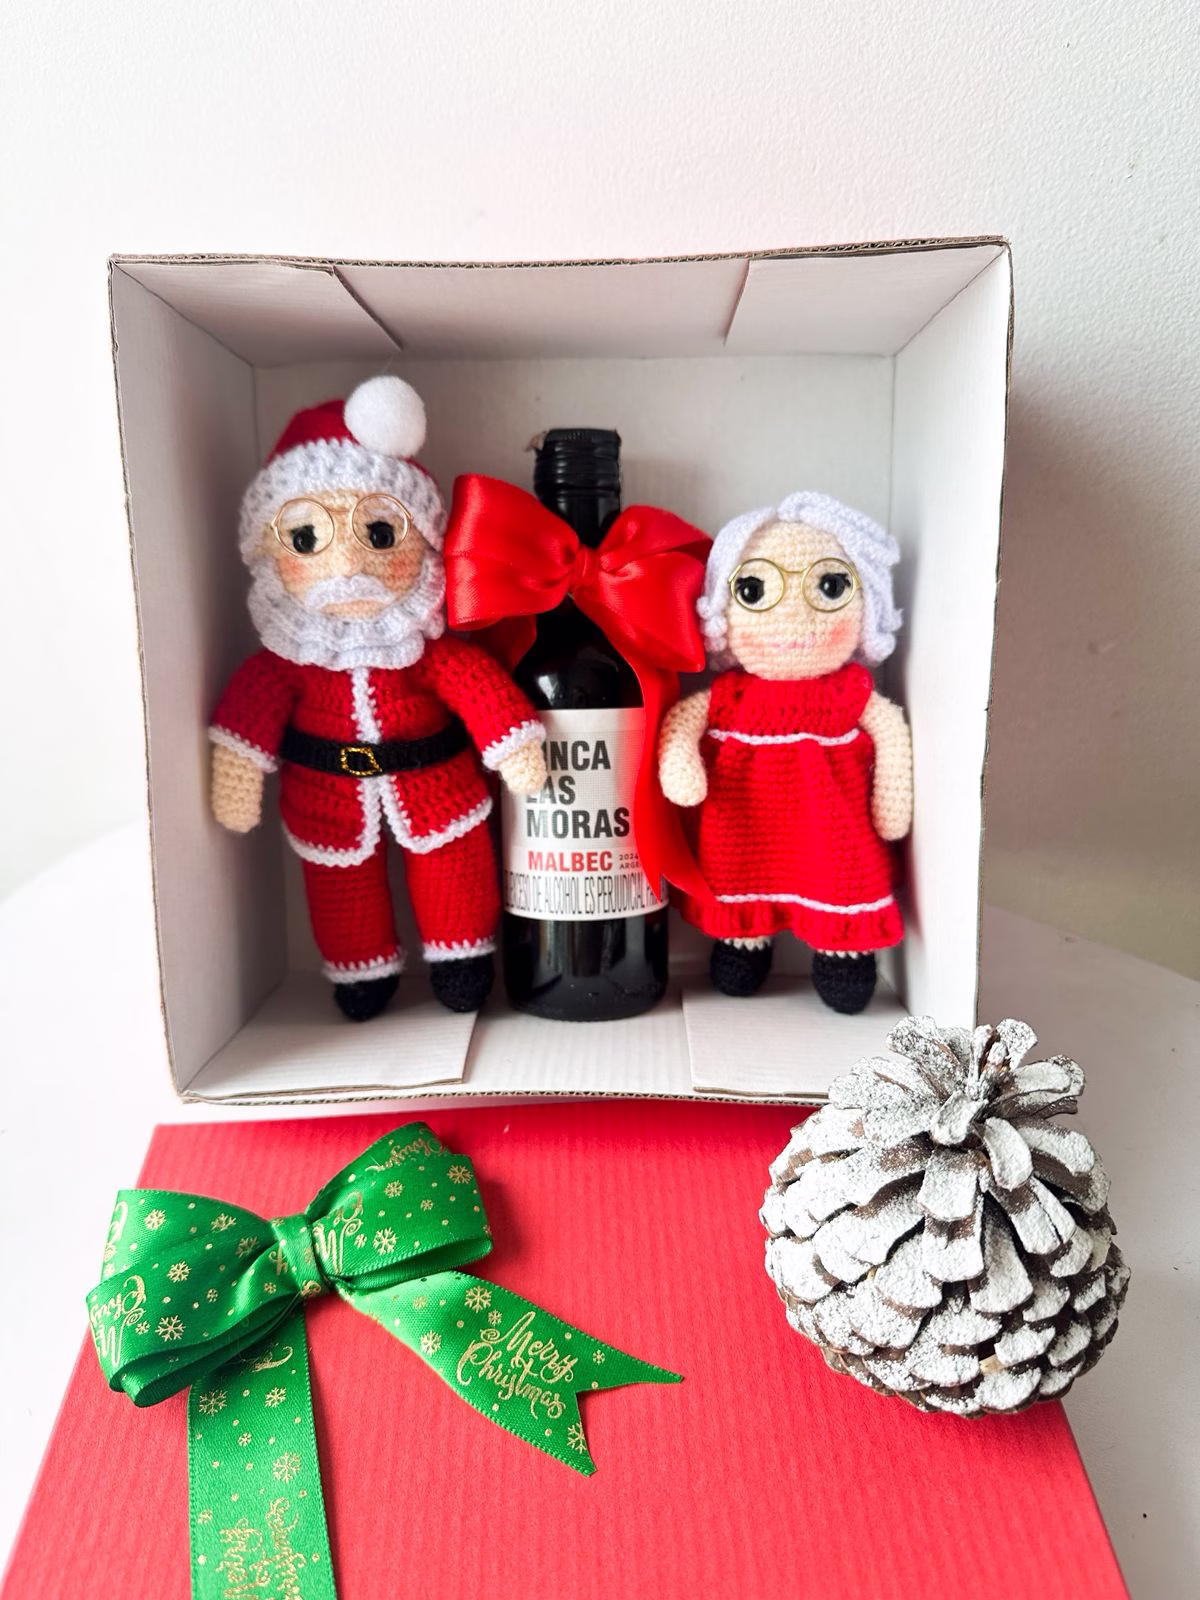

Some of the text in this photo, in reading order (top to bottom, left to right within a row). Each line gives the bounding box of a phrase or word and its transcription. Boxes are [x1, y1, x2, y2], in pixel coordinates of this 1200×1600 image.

[526, 807, 630, 839] MORAS
[527, 851, 613, 872] MALBEC
[532, 876, 542, 913] DE
[544, 876, 583, 915] ALCOHOL
[585, 876, 595, 915] ES
[597, 872, 646, 914] PERJUDICIAL
[480, 1311, 578, 1383] Merry
[457, 1340, 566, 1419] Christmas
